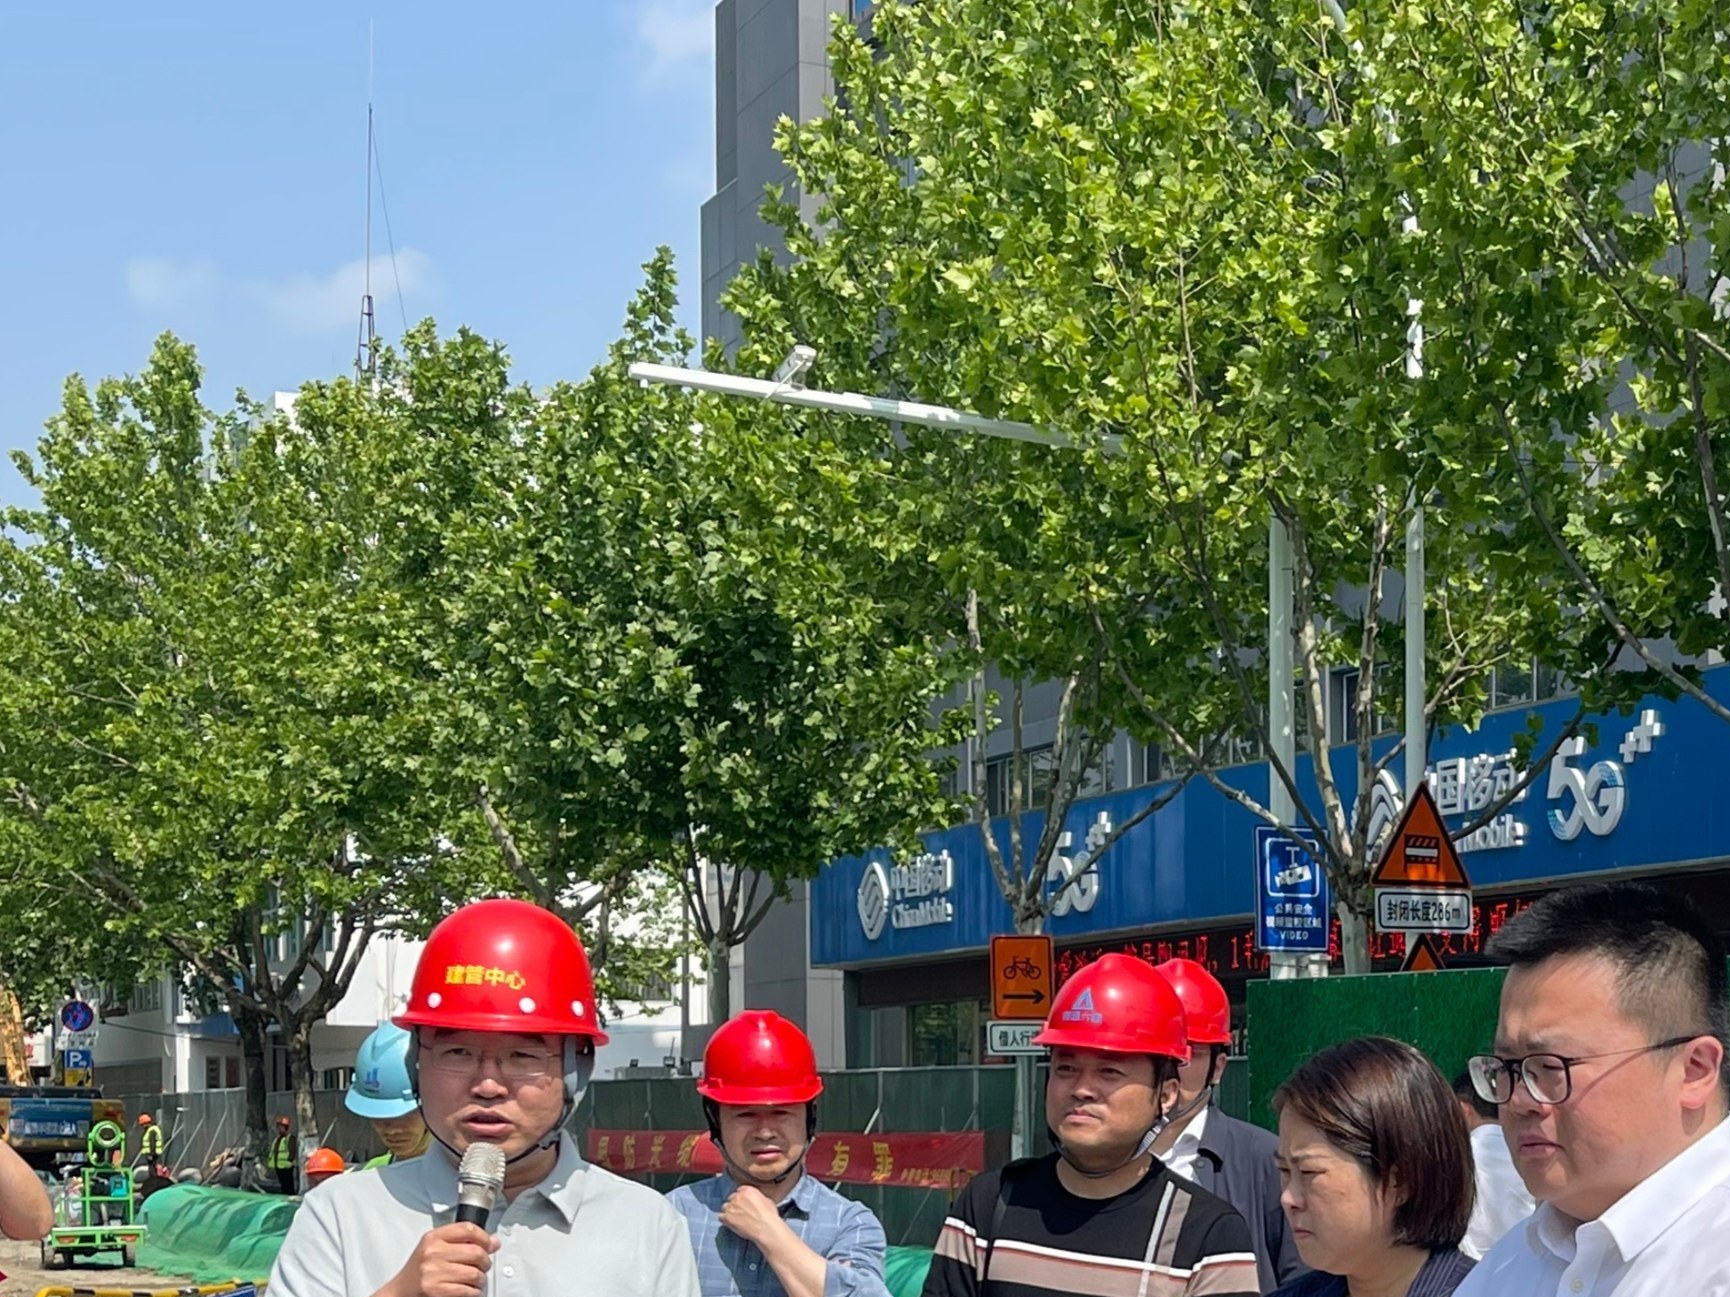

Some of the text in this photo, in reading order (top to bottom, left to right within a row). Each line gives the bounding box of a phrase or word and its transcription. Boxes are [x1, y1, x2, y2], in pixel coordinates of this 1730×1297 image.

[1425, 748, 1527, 815] 国移动
[1275, 903, 1313, 915] 公共安全
[1387, 900, 1462, 922] 封闭长度286m
[1280, 931, 1309, 940] VIDEO
[445, 965, 526, 990] 建管中心
